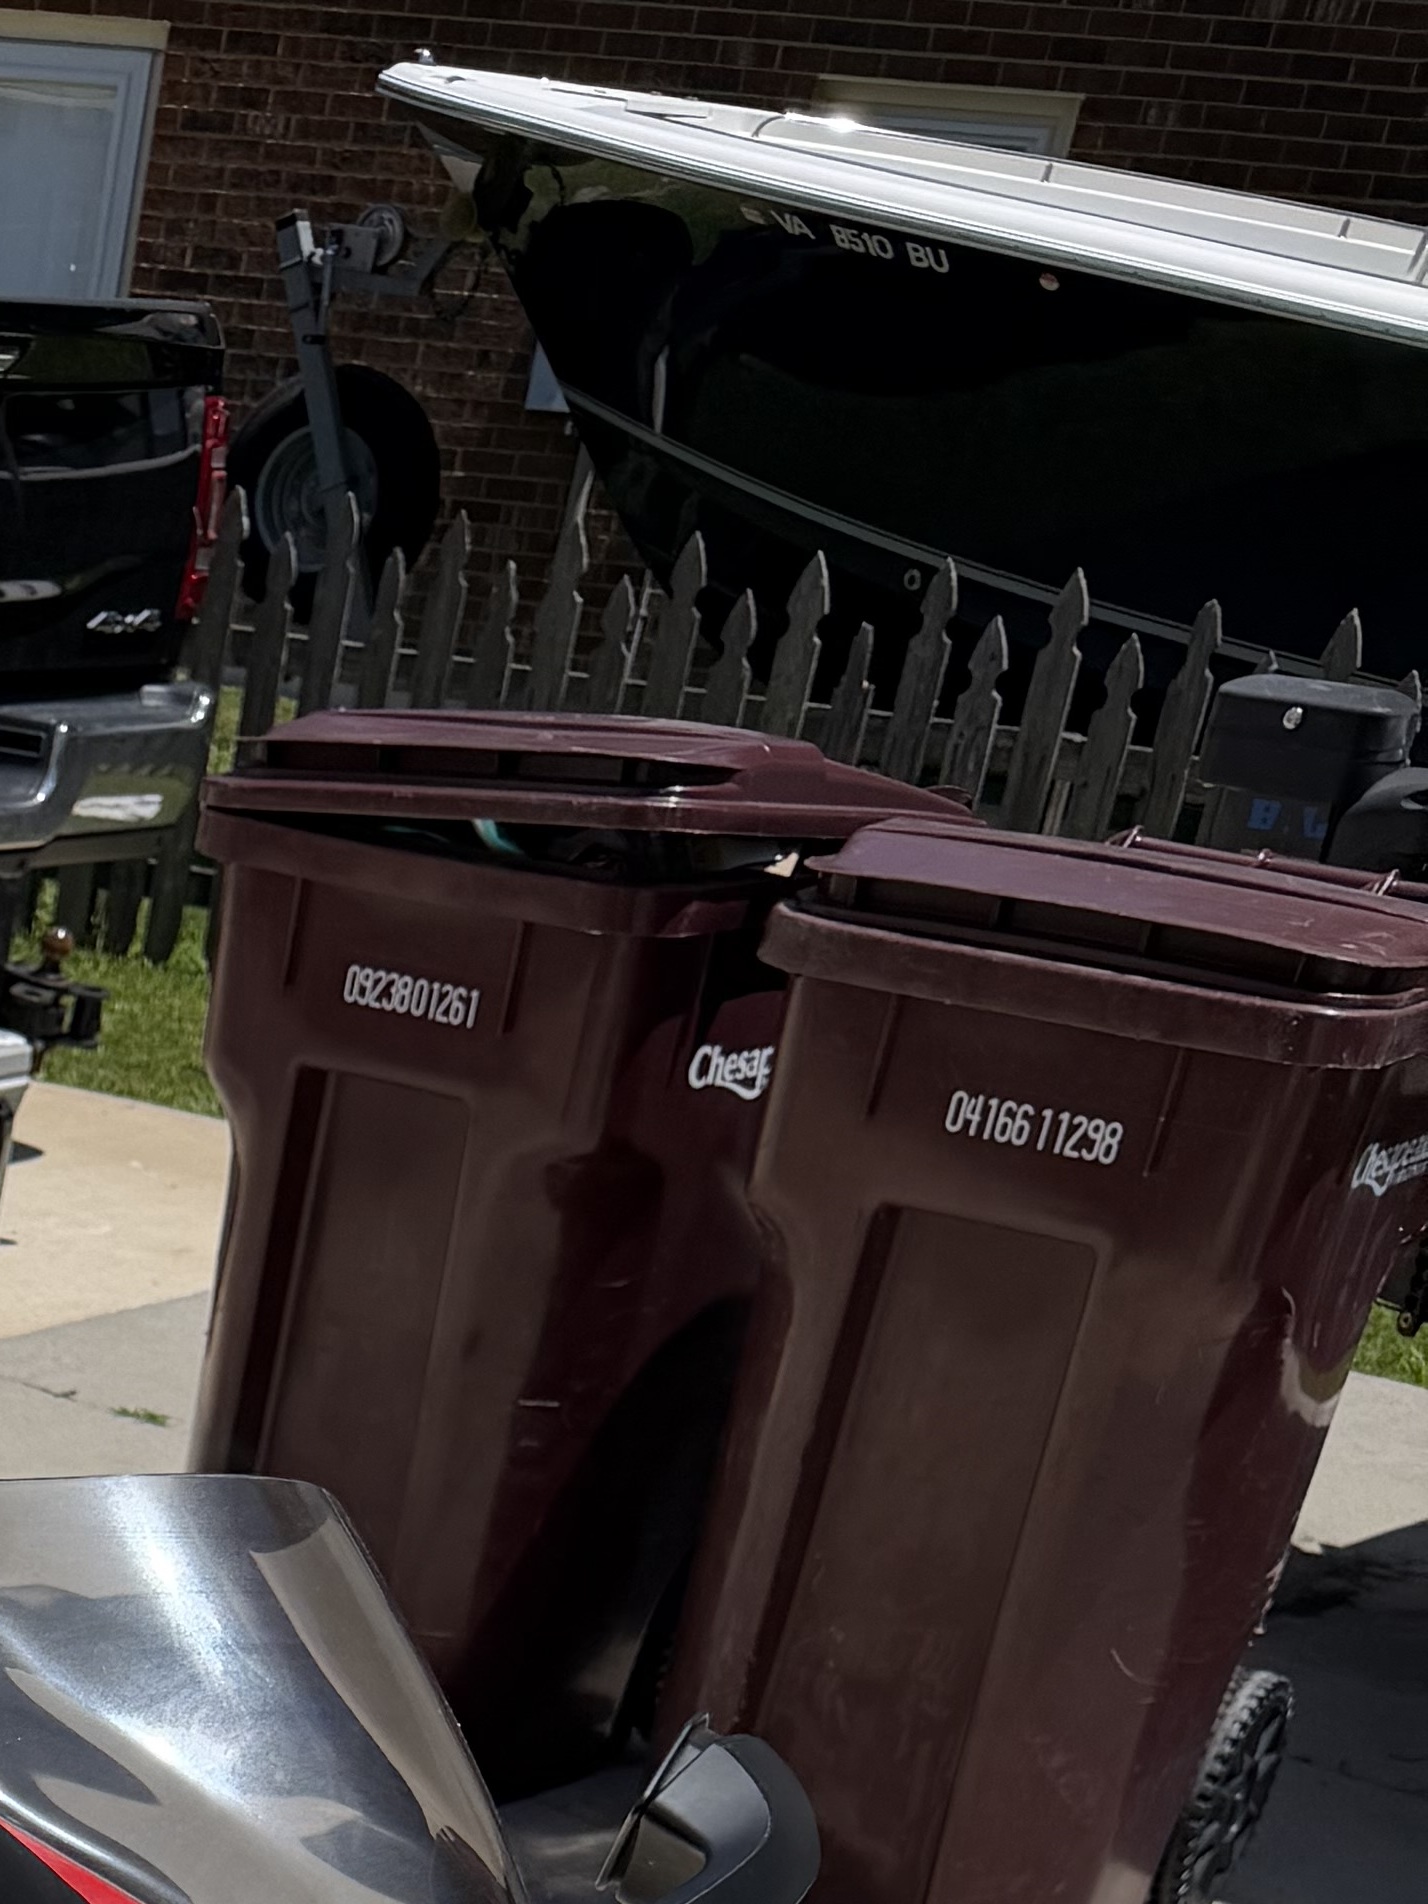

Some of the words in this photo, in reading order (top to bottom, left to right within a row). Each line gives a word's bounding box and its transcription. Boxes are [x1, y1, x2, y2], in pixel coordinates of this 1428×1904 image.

[770, 209, 816, 240] VA
[830, 223, 895, 260] 8510
[905, 241, 950, 273] BU
[343, 964, 481, 1030] 0923801261
